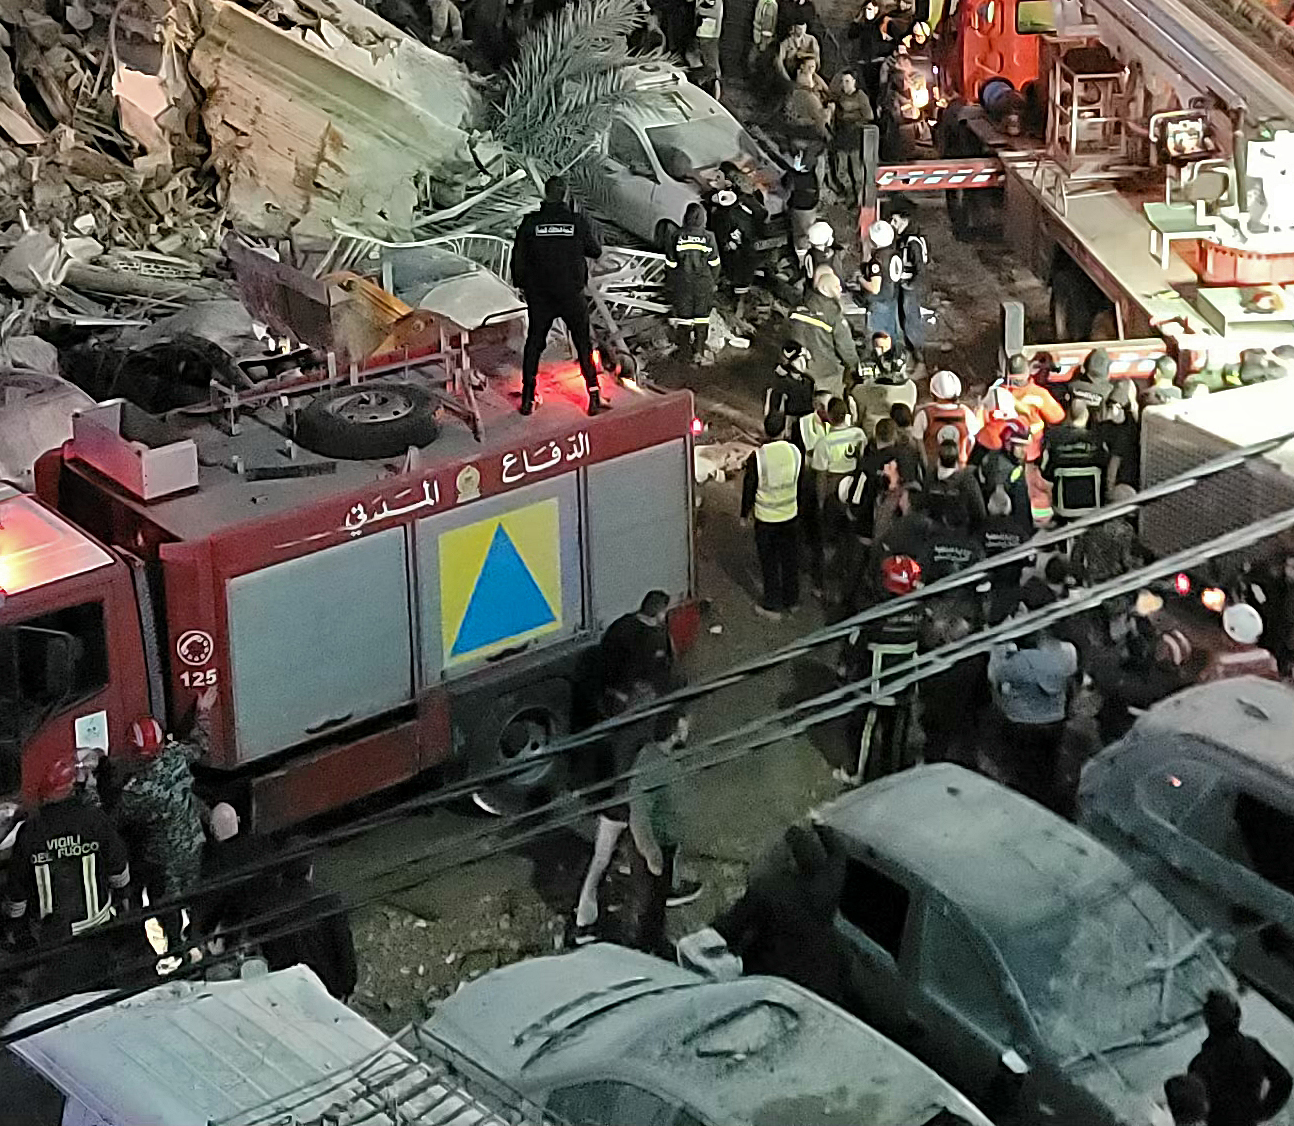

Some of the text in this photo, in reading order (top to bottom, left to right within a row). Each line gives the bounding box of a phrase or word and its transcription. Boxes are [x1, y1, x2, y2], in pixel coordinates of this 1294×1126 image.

[180, 668, 217, 687] 125
[46, 834, 81, 851] VIGILI
[58, 842, 99, 859] FUOCO
